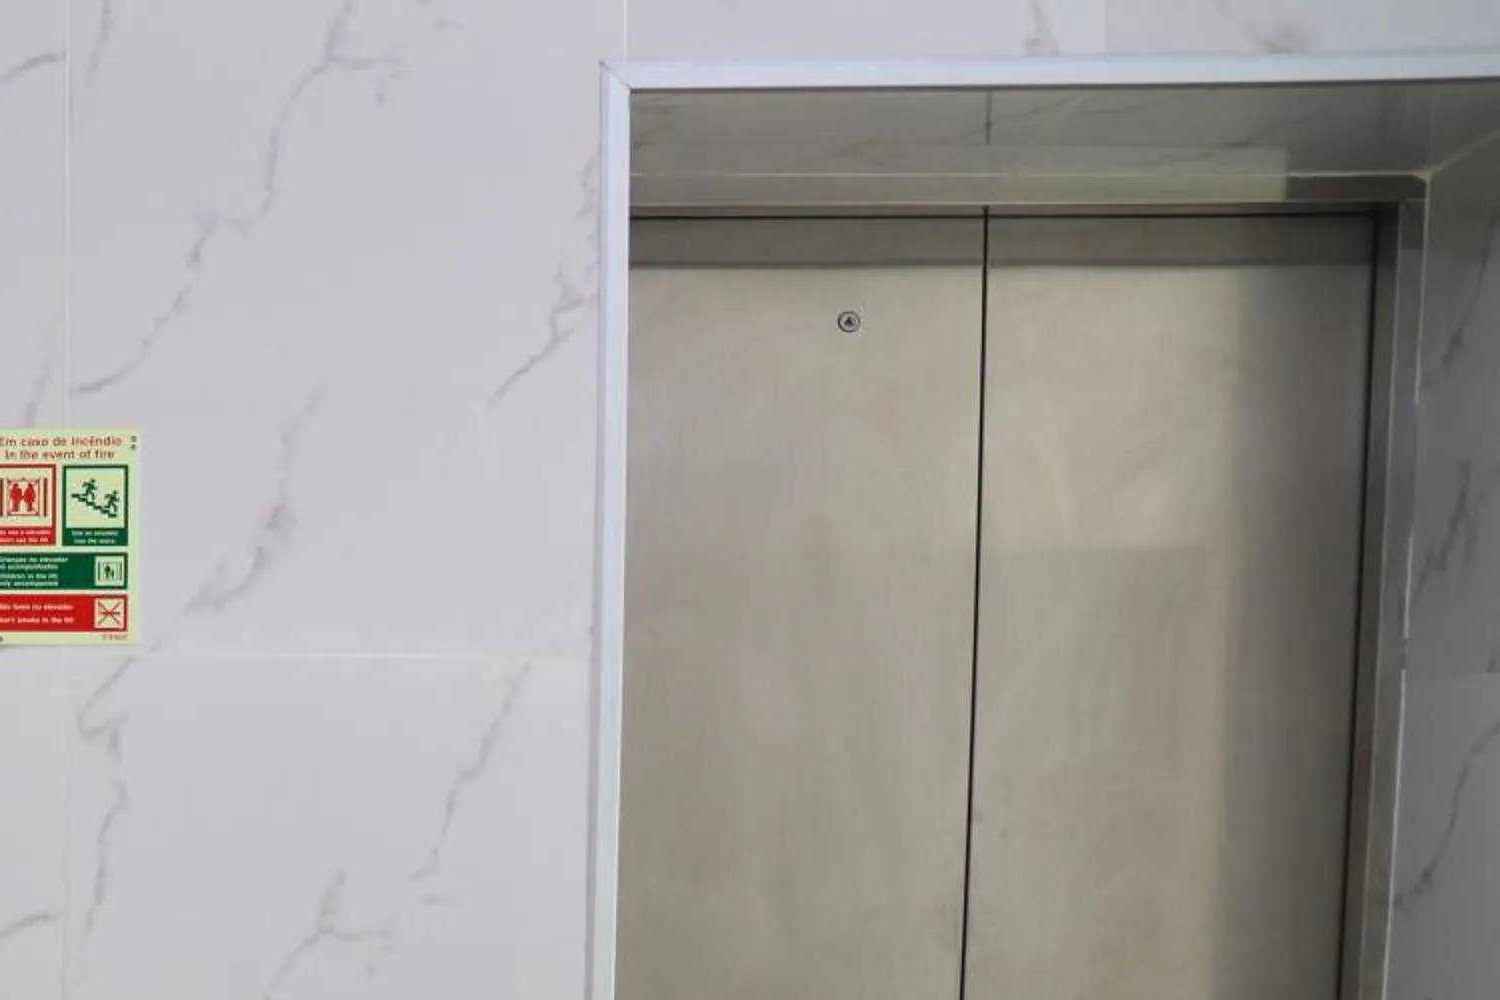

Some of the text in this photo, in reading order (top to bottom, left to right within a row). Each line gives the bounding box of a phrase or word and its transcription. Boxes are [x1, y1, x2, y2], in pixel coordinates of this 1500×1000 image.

[52, 436, 68, 446] de
[19, 450, 39, 459] the
[42, 450, 75, 459] event
[79, 450, 91, 459] of
